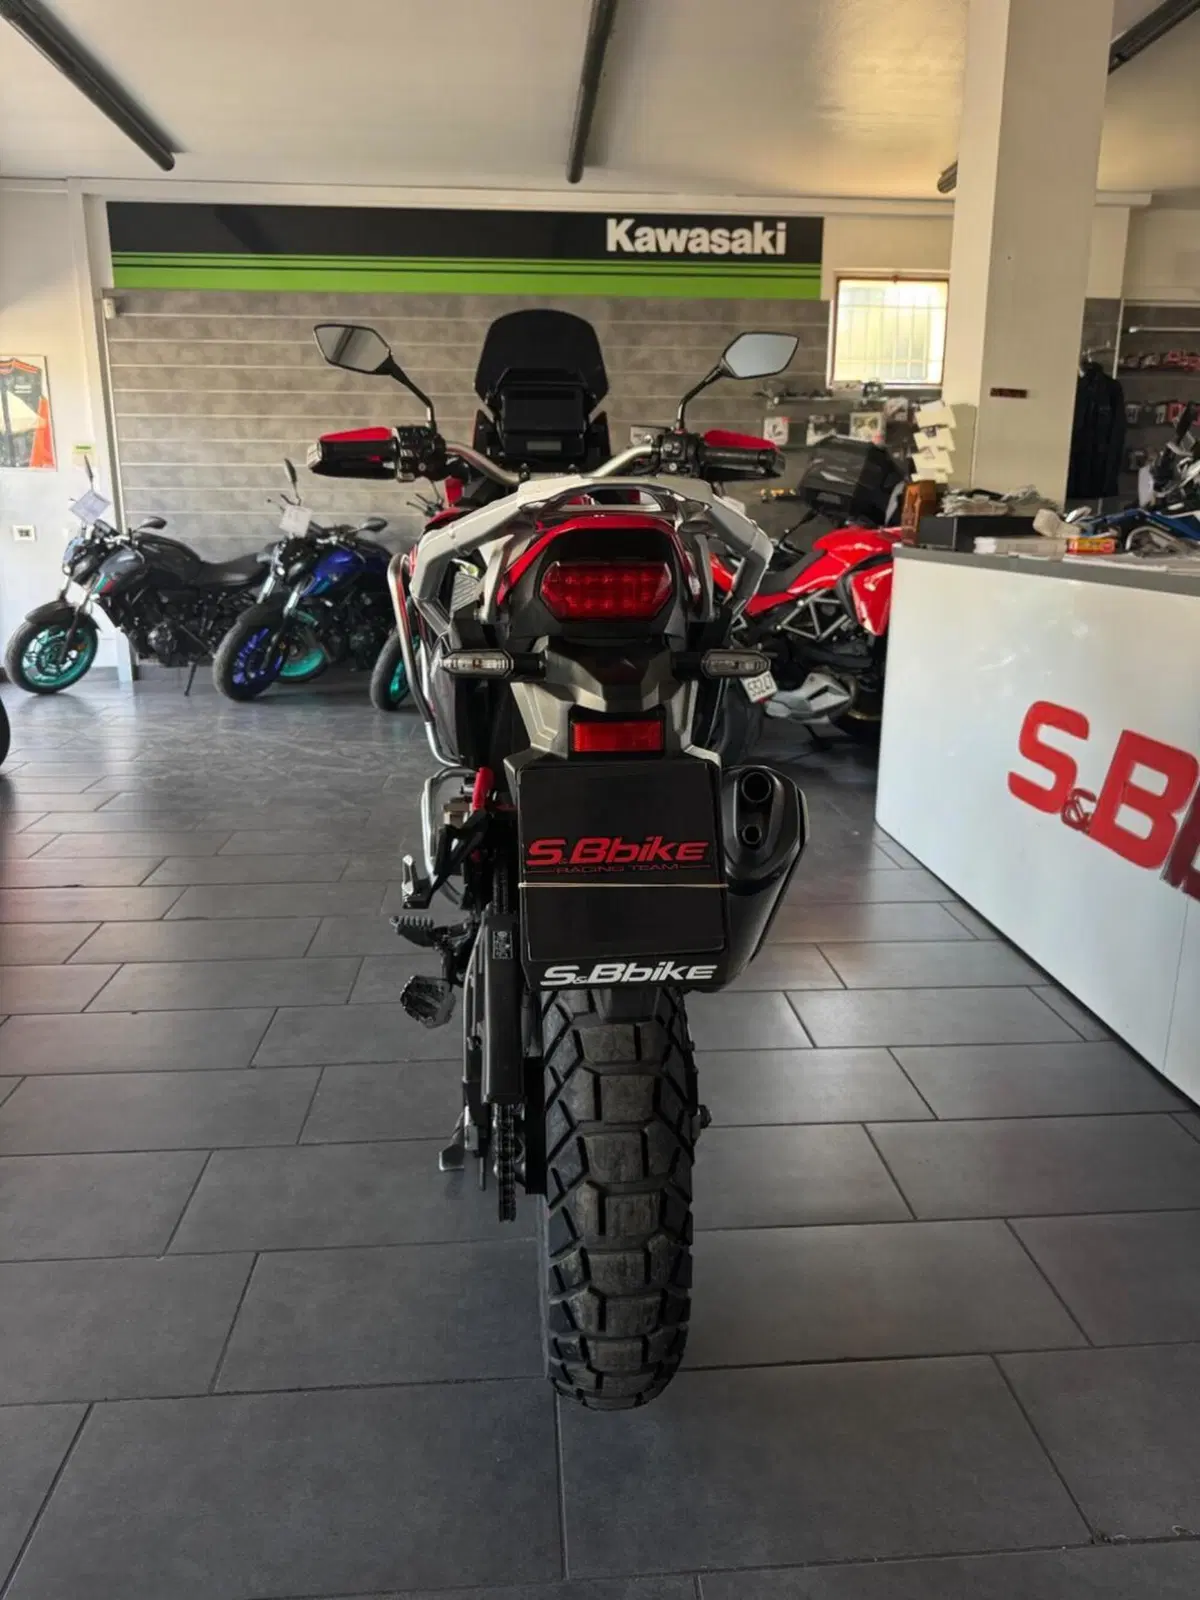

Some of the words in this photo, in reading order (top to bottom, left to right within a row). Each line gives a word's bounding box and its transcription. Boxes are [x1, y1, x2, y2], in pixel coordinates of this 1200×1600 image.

[606, 218, 787, 255] Kawasaki
[556, 864, 625, 874] RACING
[631, 862, 679, 872] TEAM
[540, 961, 718, 986] S&Bbike
